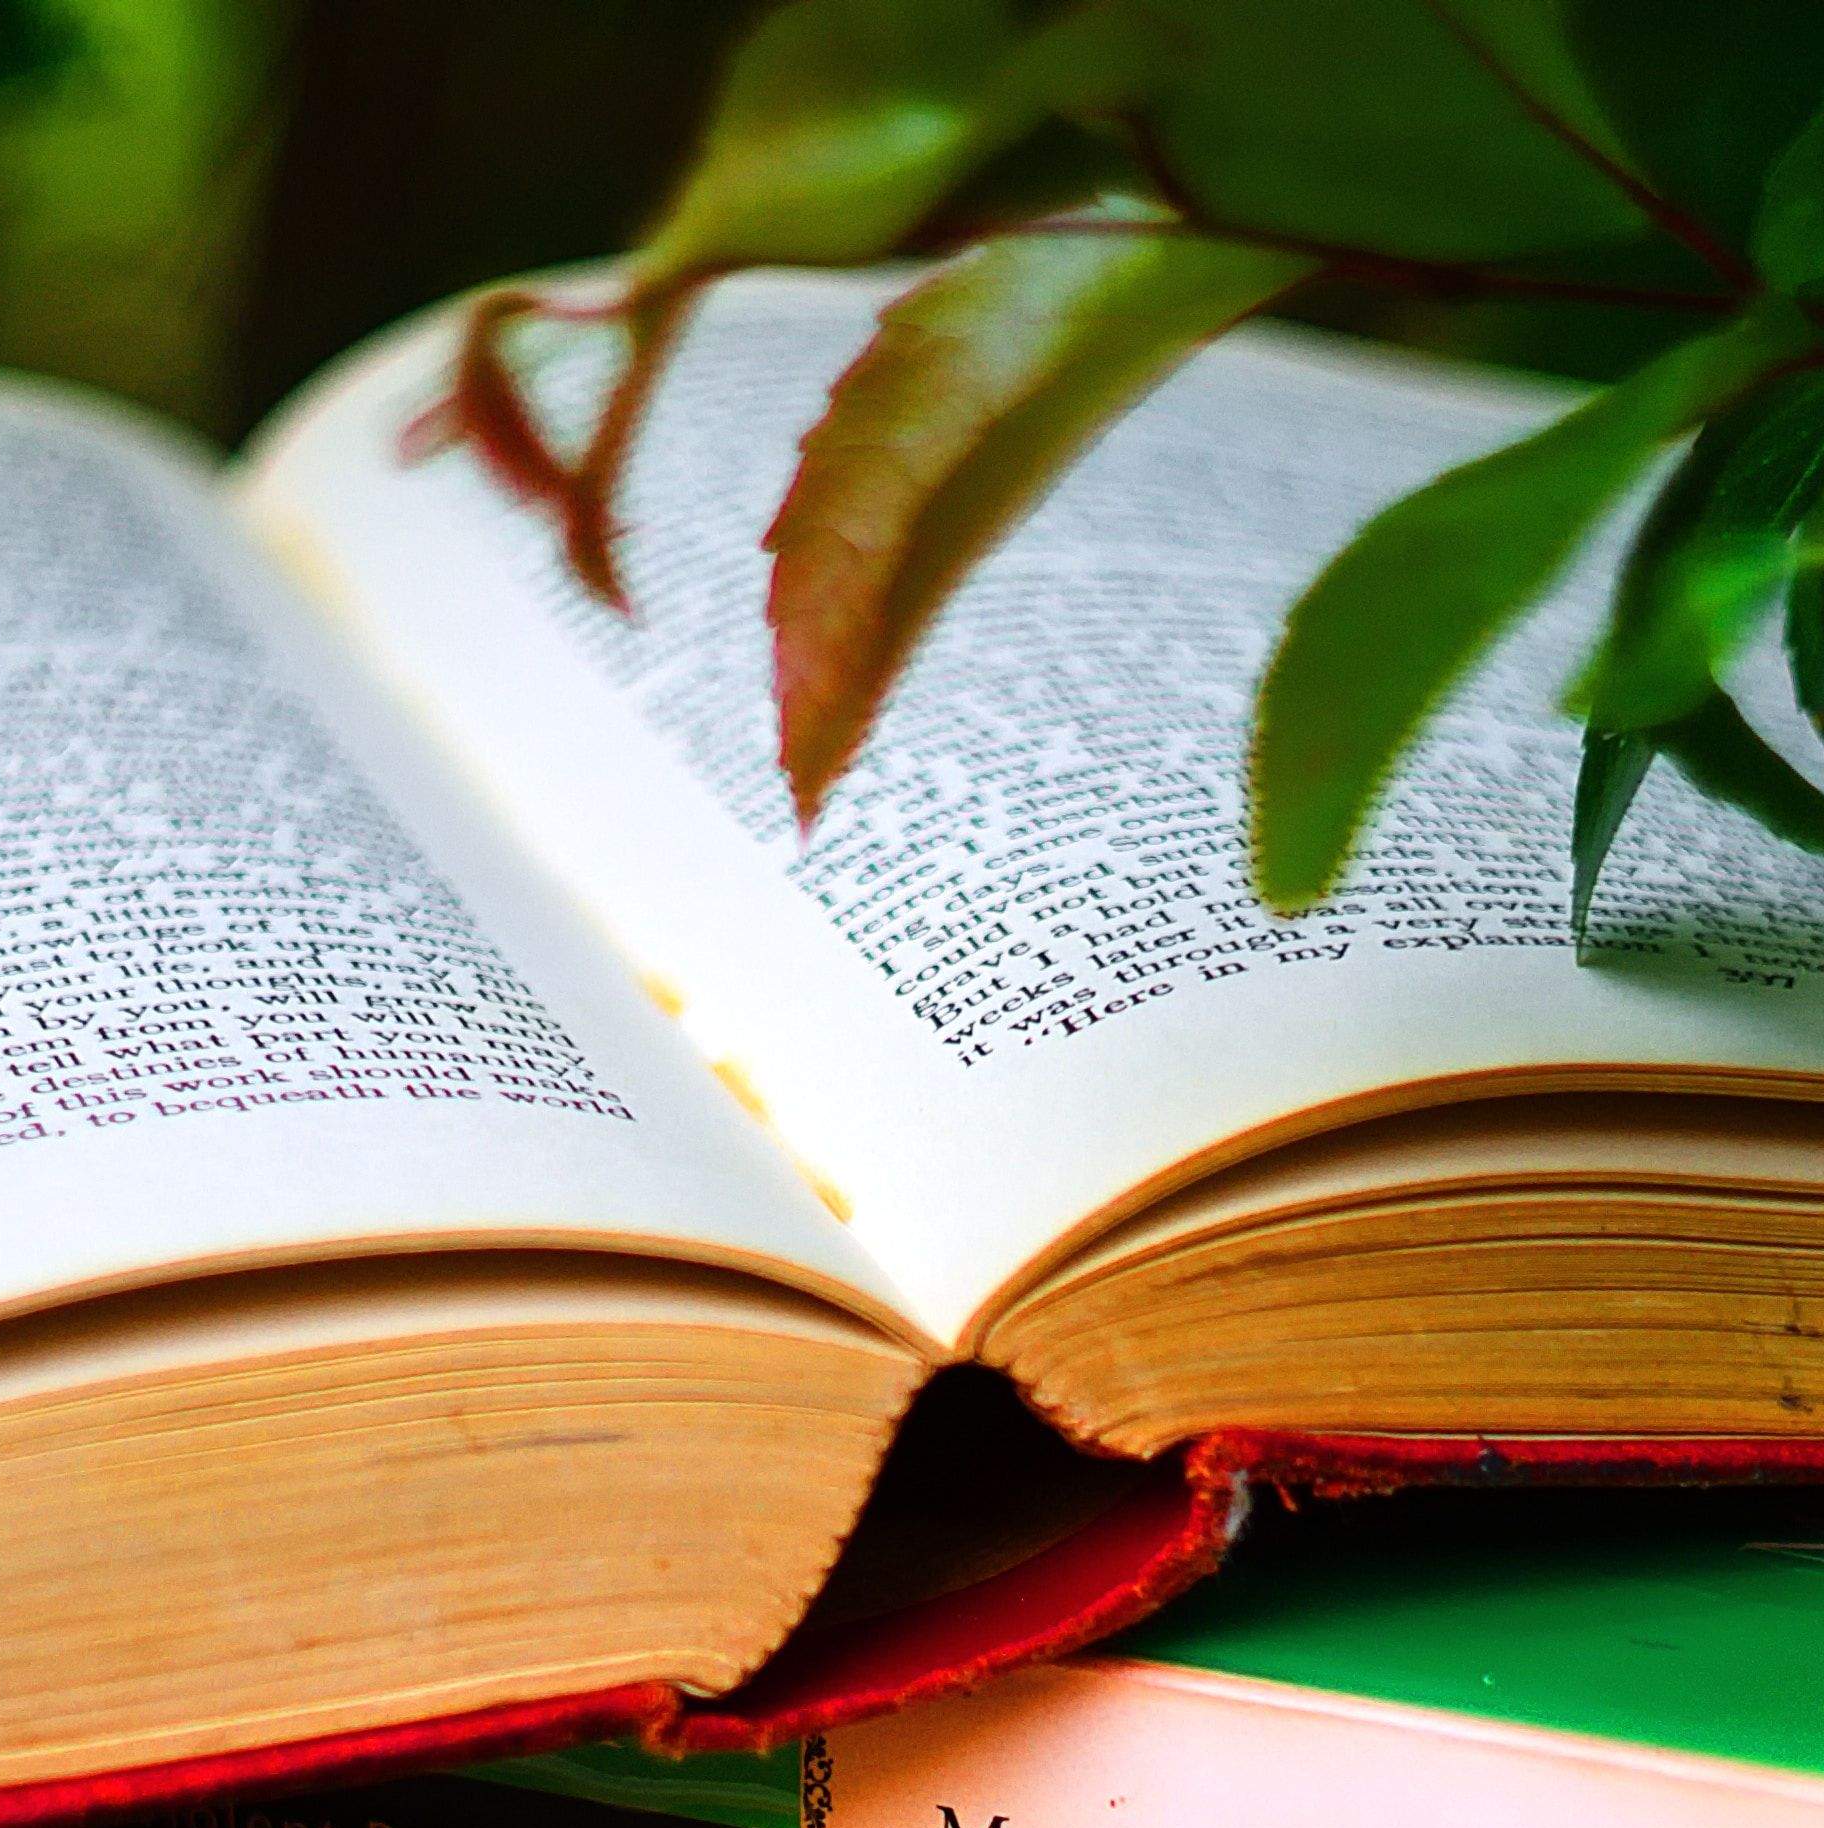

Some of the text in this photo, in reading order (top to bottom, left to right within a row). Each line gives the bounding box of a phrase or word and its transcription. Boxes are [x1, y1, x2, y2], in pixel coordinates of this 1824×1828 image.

[943, 973, 1075, 1045] weeks
[1087, 927, 1197, 970] later
[1215, 915, 1256, 933] it
[1273, 901, 1366, 921] was
[1385, 897, 1447, 913] all
[1198, 961, 1249, 983] in
[1274, 943, 1350, 964] my
[958, 916, 1480, 1068] it was through a very
[6, 1050, 85, 1077] tell
[103, 1033, 229, 1059] what
[246, 1025, 354, 1052] part
[370, 1029, 464, 1054] you
[482, 1037, 585, 1071] may
[31, 1055, 242, 1094] destinies
[264, 1044, 314, 1064] of
[333, 1038, 595, 1089] humanity?
[55, 1086, 148, 1111] this
[163, 1068, 290, 1093] work
[308, 1060, 475, 1082] should
[488, 1063, 621, 1103] make
[86, 1110, 137, 1127] to
[151, 1082, 388, 1116] bequeath
[403, 1078, 481, 1100] the
[499, 1082, 636, 1121] world
